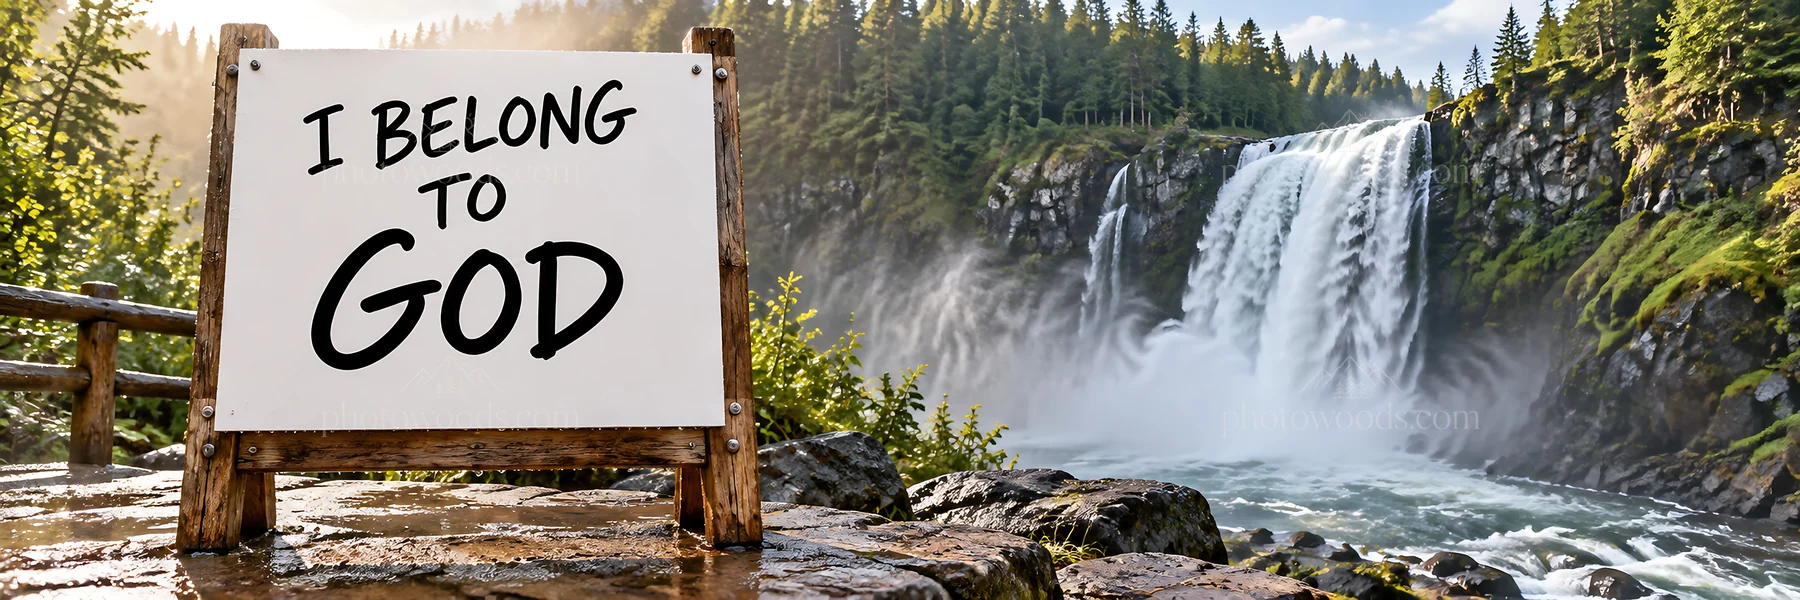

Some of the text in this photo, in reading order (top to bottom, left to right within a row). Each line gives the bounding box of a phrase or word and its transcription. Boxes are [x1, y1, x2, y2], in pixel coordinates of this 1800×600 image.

[302, 79, 638, 176] I BELONG
[417, 172, 507, 230] TO
[310, 228, 624, 371] GOD
